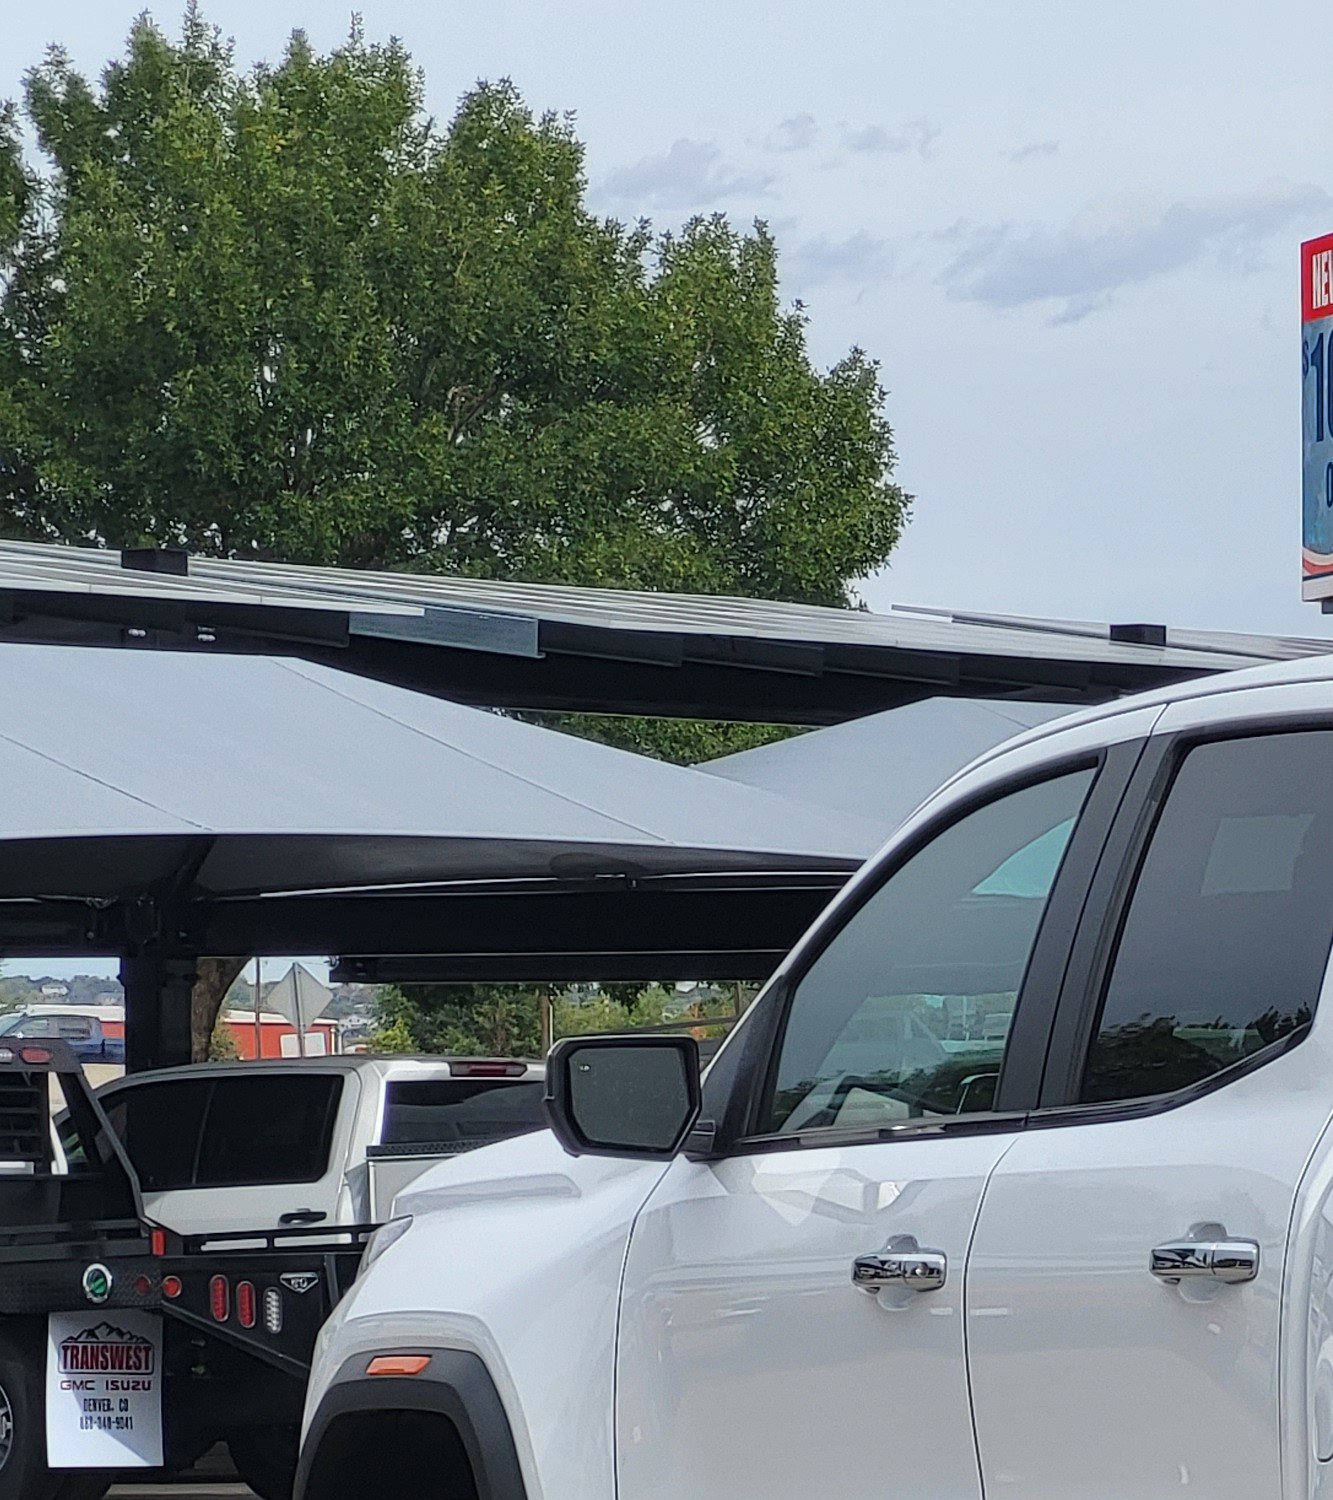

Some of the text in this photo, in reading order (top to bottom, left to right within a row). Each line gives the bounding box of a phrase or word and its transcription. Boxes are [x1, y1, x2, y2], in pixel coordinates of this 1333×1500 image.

[61, 1344, 152, 1371] TRANSWEST
[60, 1380, 152, 1391] GMC ISUZU
